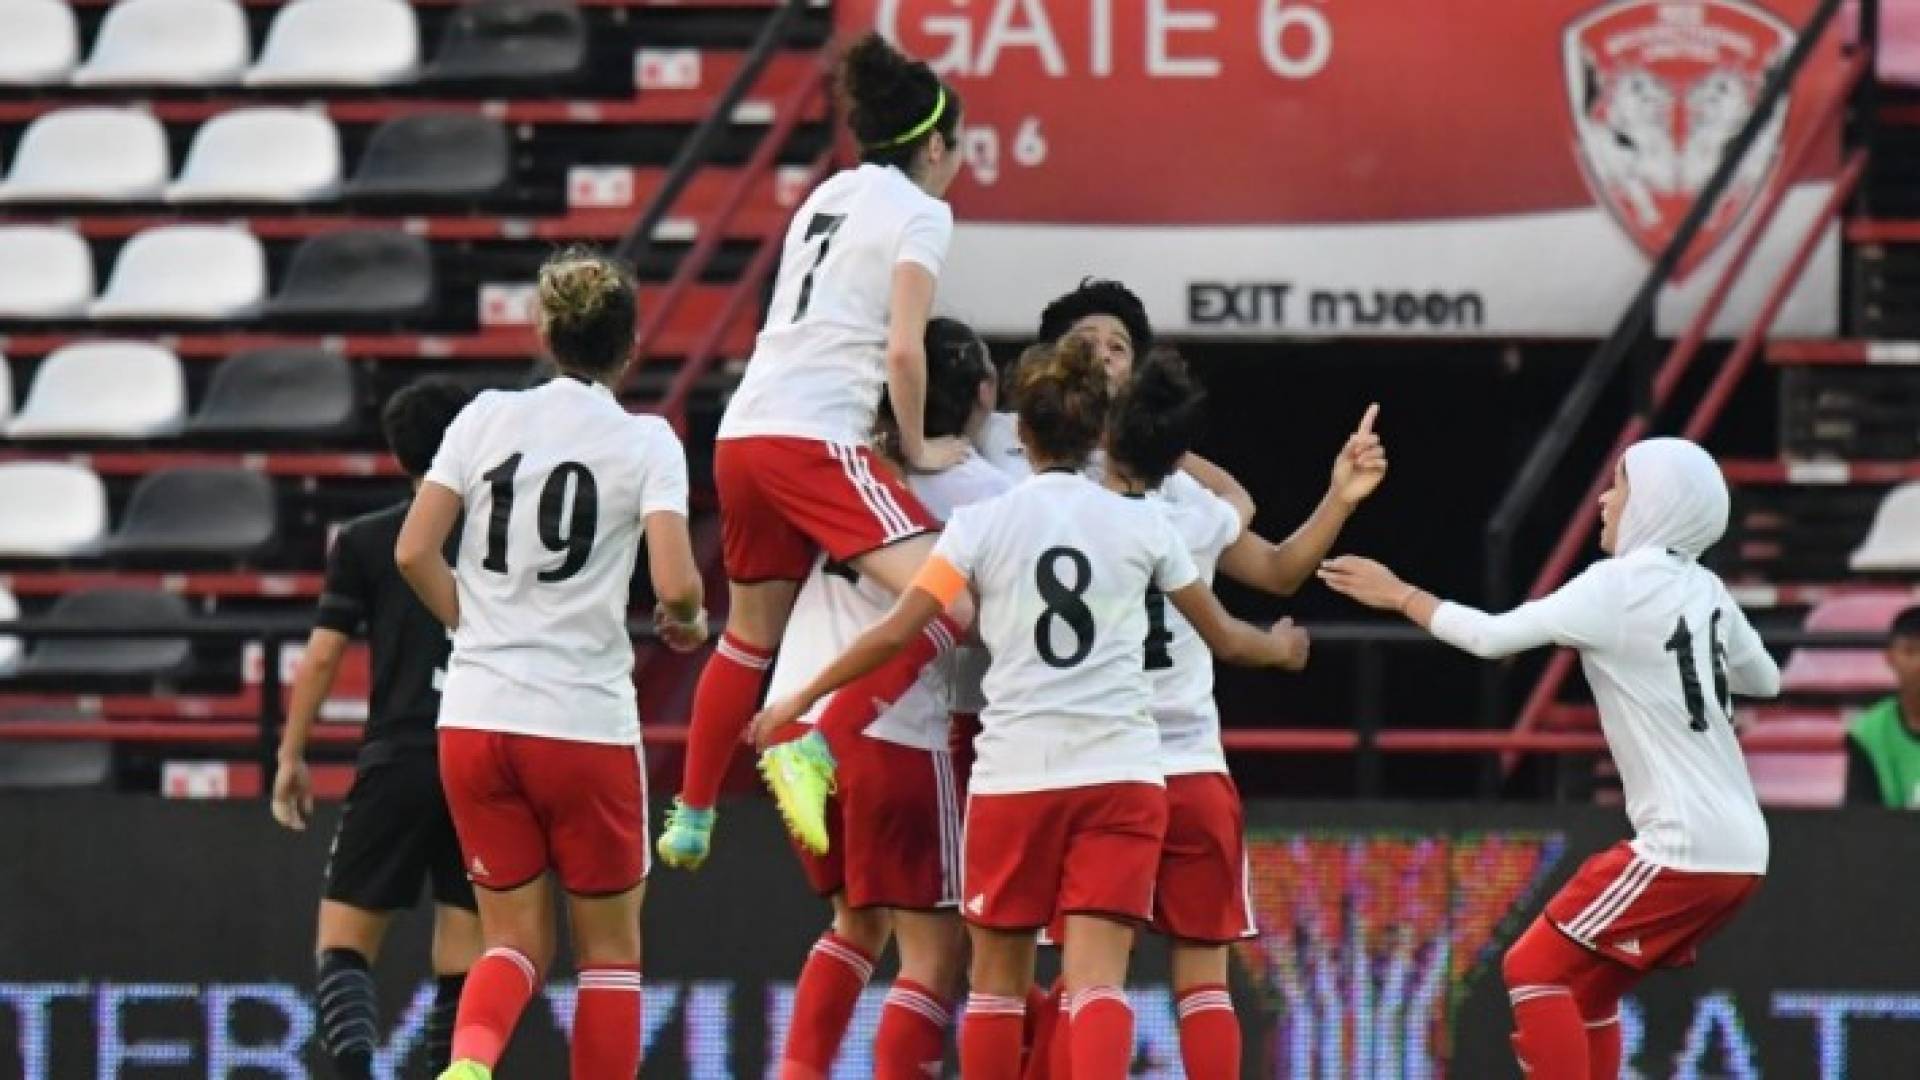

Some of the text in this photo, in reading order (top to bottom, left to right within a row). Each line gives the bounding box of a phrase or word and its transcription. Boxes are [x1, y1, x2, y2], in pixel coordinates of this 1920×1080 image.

[1258, 0, 1334, 80] 6
[1013, 115, 1047, 168] 6
[791, 213, 848, 324] 7
[1187, 284, 1295, 324] EXIT
[482, 452, 598, 584] 19
[1034, 546, 1096, 669] 8
